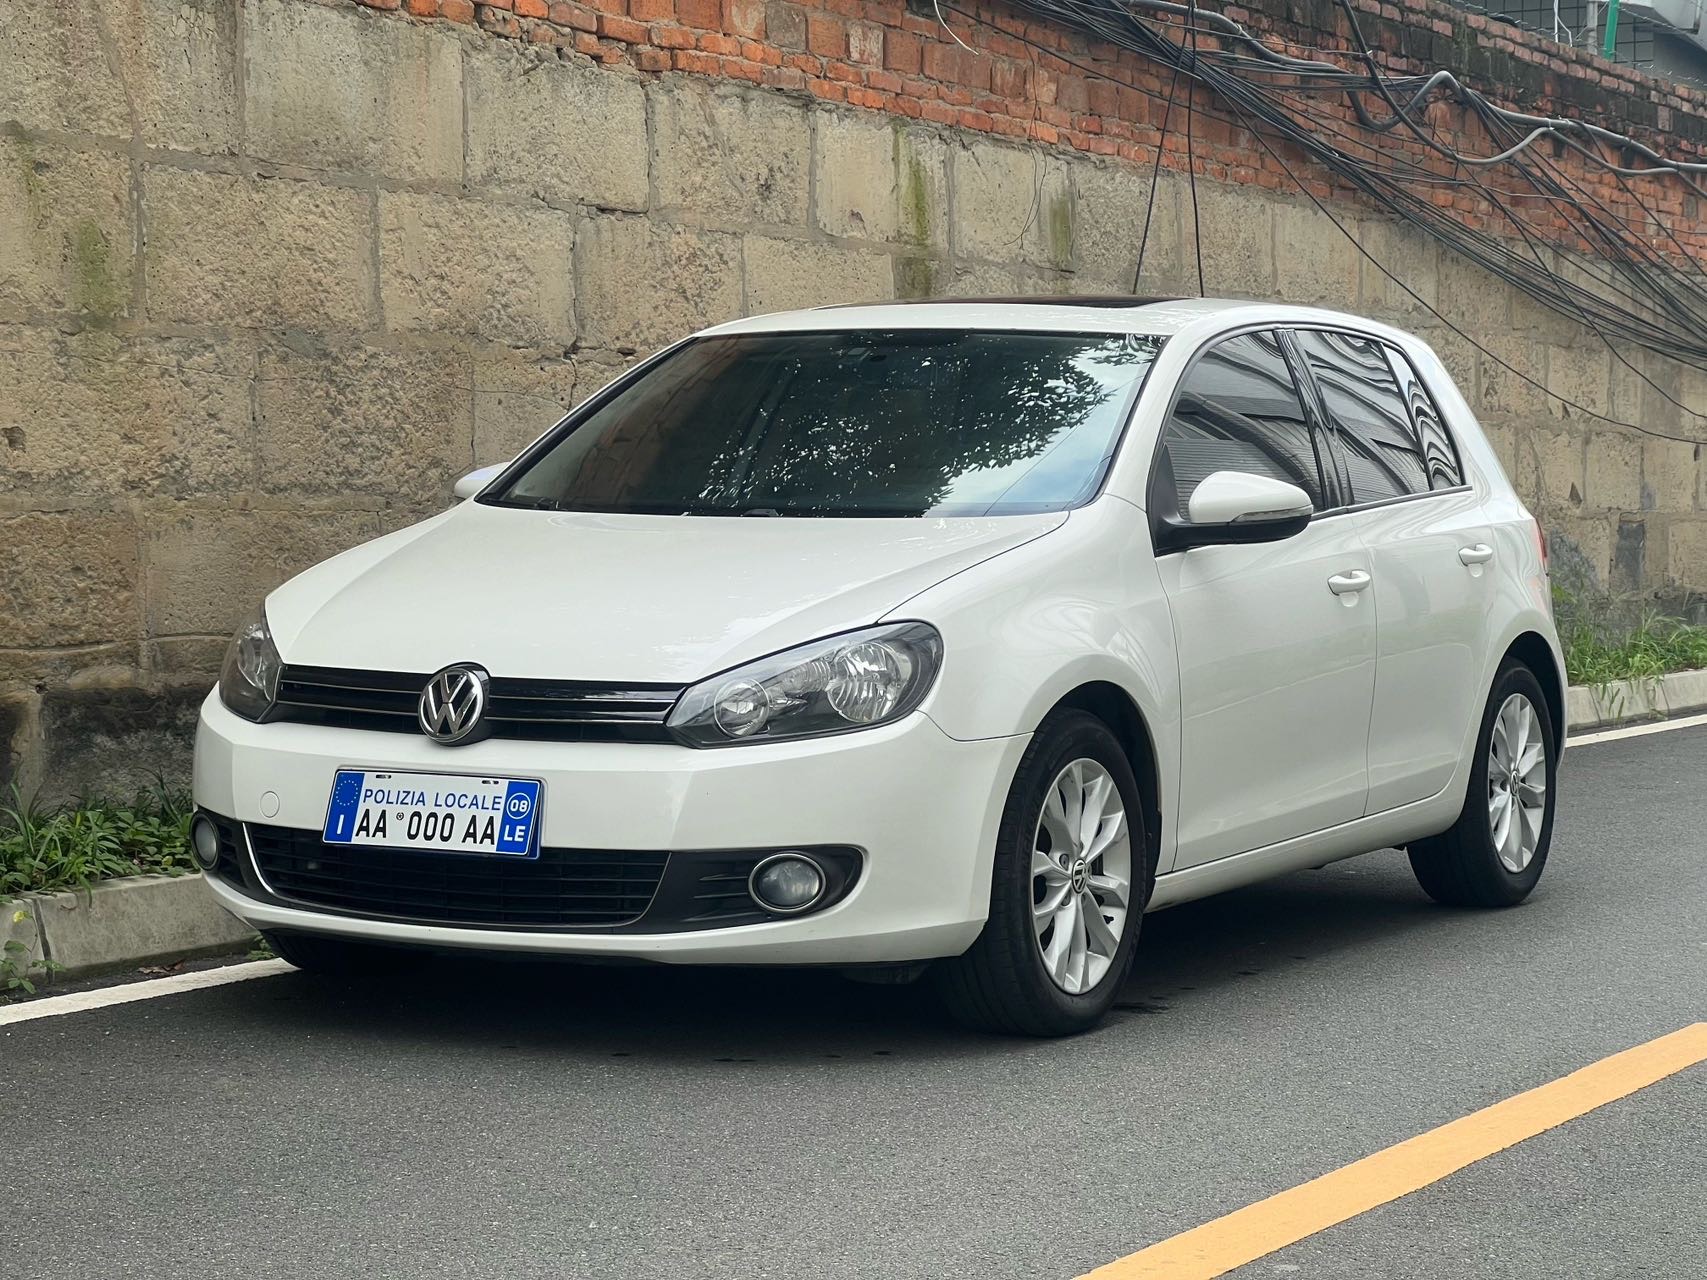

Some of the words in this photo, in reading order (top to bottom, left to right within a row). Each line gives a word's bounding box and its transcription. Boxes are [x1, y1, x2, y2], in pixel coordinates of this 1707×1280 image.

[363, 789, 426, 806] POLIZIA
[434, 792, 503, 811] LOCALE
[510, 800, 528, 812] 08
[336, 815, 344, 834] I
[355, 808, 387, 838] AA
[407, 811, 455, 842] 000
[462, 814, 495, 845] AA
[503, 825, 526, 842] LE
